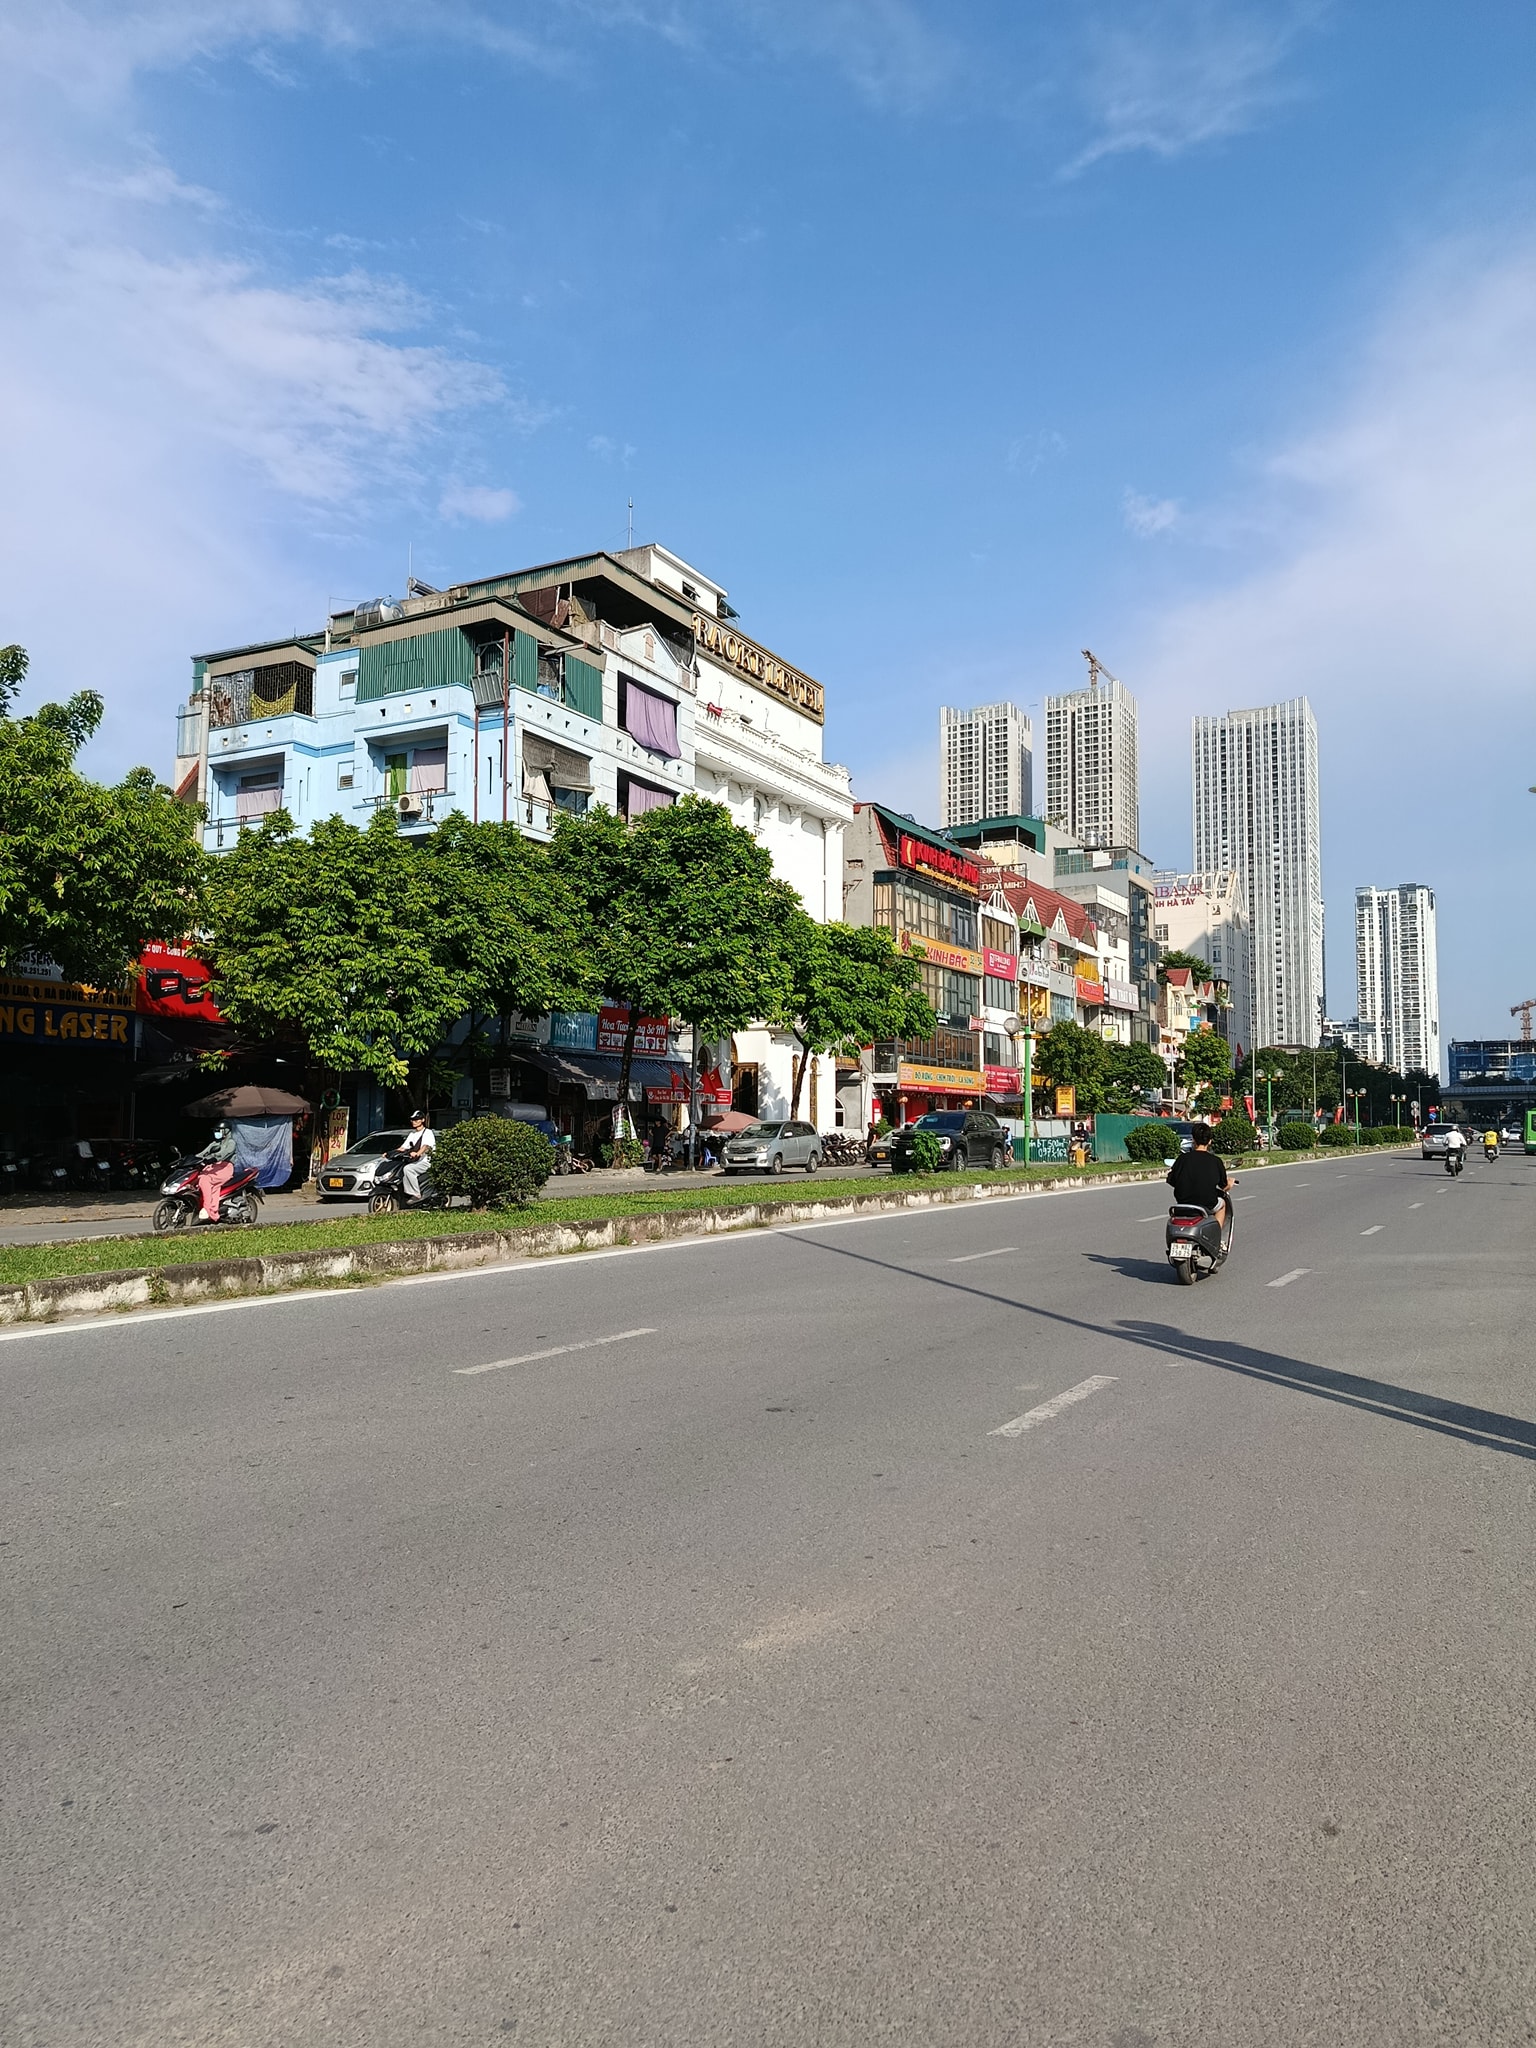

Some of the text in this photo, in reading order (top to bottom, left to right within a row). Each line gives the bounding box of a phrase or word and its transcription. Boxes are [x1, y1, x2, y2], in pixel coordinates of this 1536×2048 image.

[766, 661, 823, 713] LEVEL
[915, 842, 938, 866] KINH
[939, 848, 957, 873] BẮC
[1167, 898, 1179, 907] HÀ
[1181, 897, 1195, 905] TÂY
[926, 946, 949, 964] KINH
[950, 950, 968, 969] BẮC
[45, 986, 57, 999] HÀ
[117, 993, 132, 1007] NỘI
[44, 1009, 128, 1044] LASER
[577, 1025, 594, 1038] LINH
